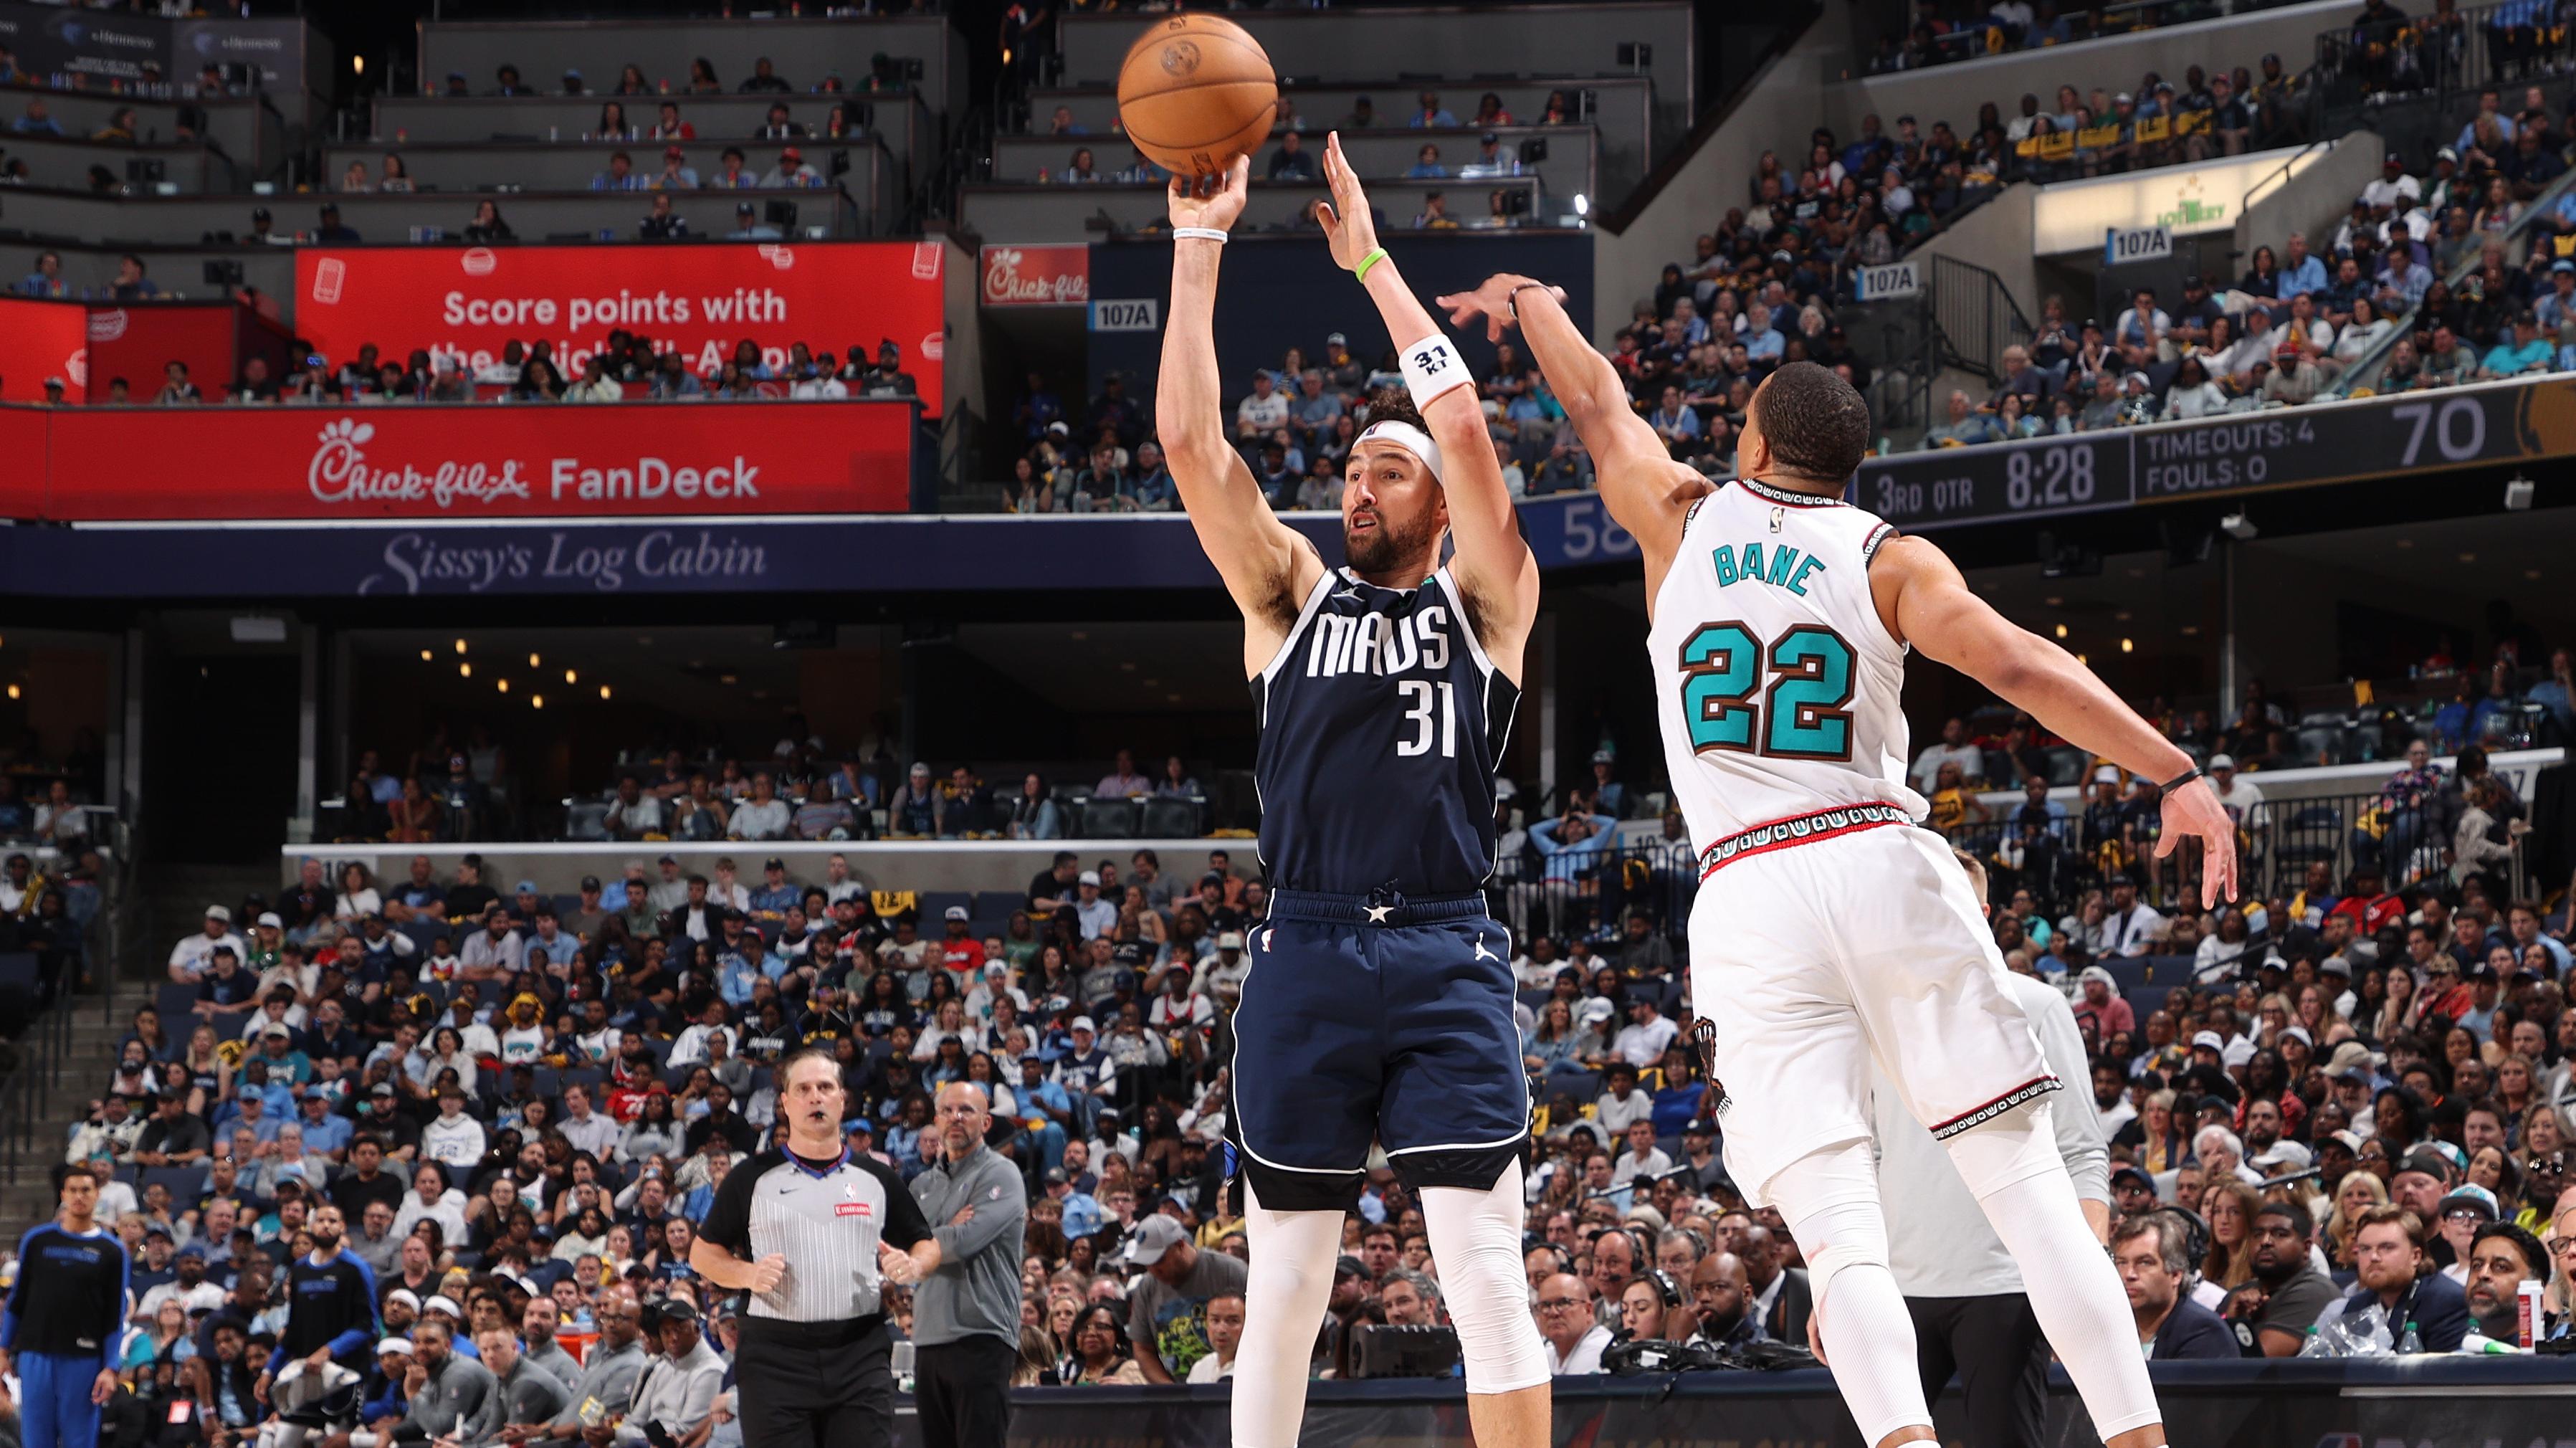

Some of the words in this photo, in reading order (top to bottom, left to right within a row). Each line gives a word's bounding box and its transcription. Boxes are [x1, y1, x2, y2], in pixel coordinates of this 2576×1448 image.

[2118, 229, 2167, 256] 107A
[1867, 266, 1913, 292] 107A
[443, 291, 558, 325] Score
[569, 288, 691, 333] points
[702, 287, 787, 323] with
[1099, 304, 1150, 325] 107A
[1413, 345, 1448, 368] 31
[1425, 358, 1447, 376] KT
[2145, 421, 2291, 461] TIMEOUTS:
[2297, 418, 2315, 444] 4
[2392, 396, 2486, 467] 70
[551, 455, 760, 500] FanDeck
[1876, 473, 1923, 515] 3RD
[1934, 477, 1974, 512] QTR
[2006, 444, 2094, 508] 8:28
[2145, 461, 2241, 492] FOULS:
[2246, 454, 2268, 482] 0
[358, 532, 533, 595] Sissy's
[542, 532, 627, 591] Log
[634, 531, 766, 576] Cabin
[1712, 542, 1826, 597] BANE
[1306, 605, 1449, 677] MAVS
[1679, 619, 1859, 763] 22
[1397, 680, 1456, 758] 31
